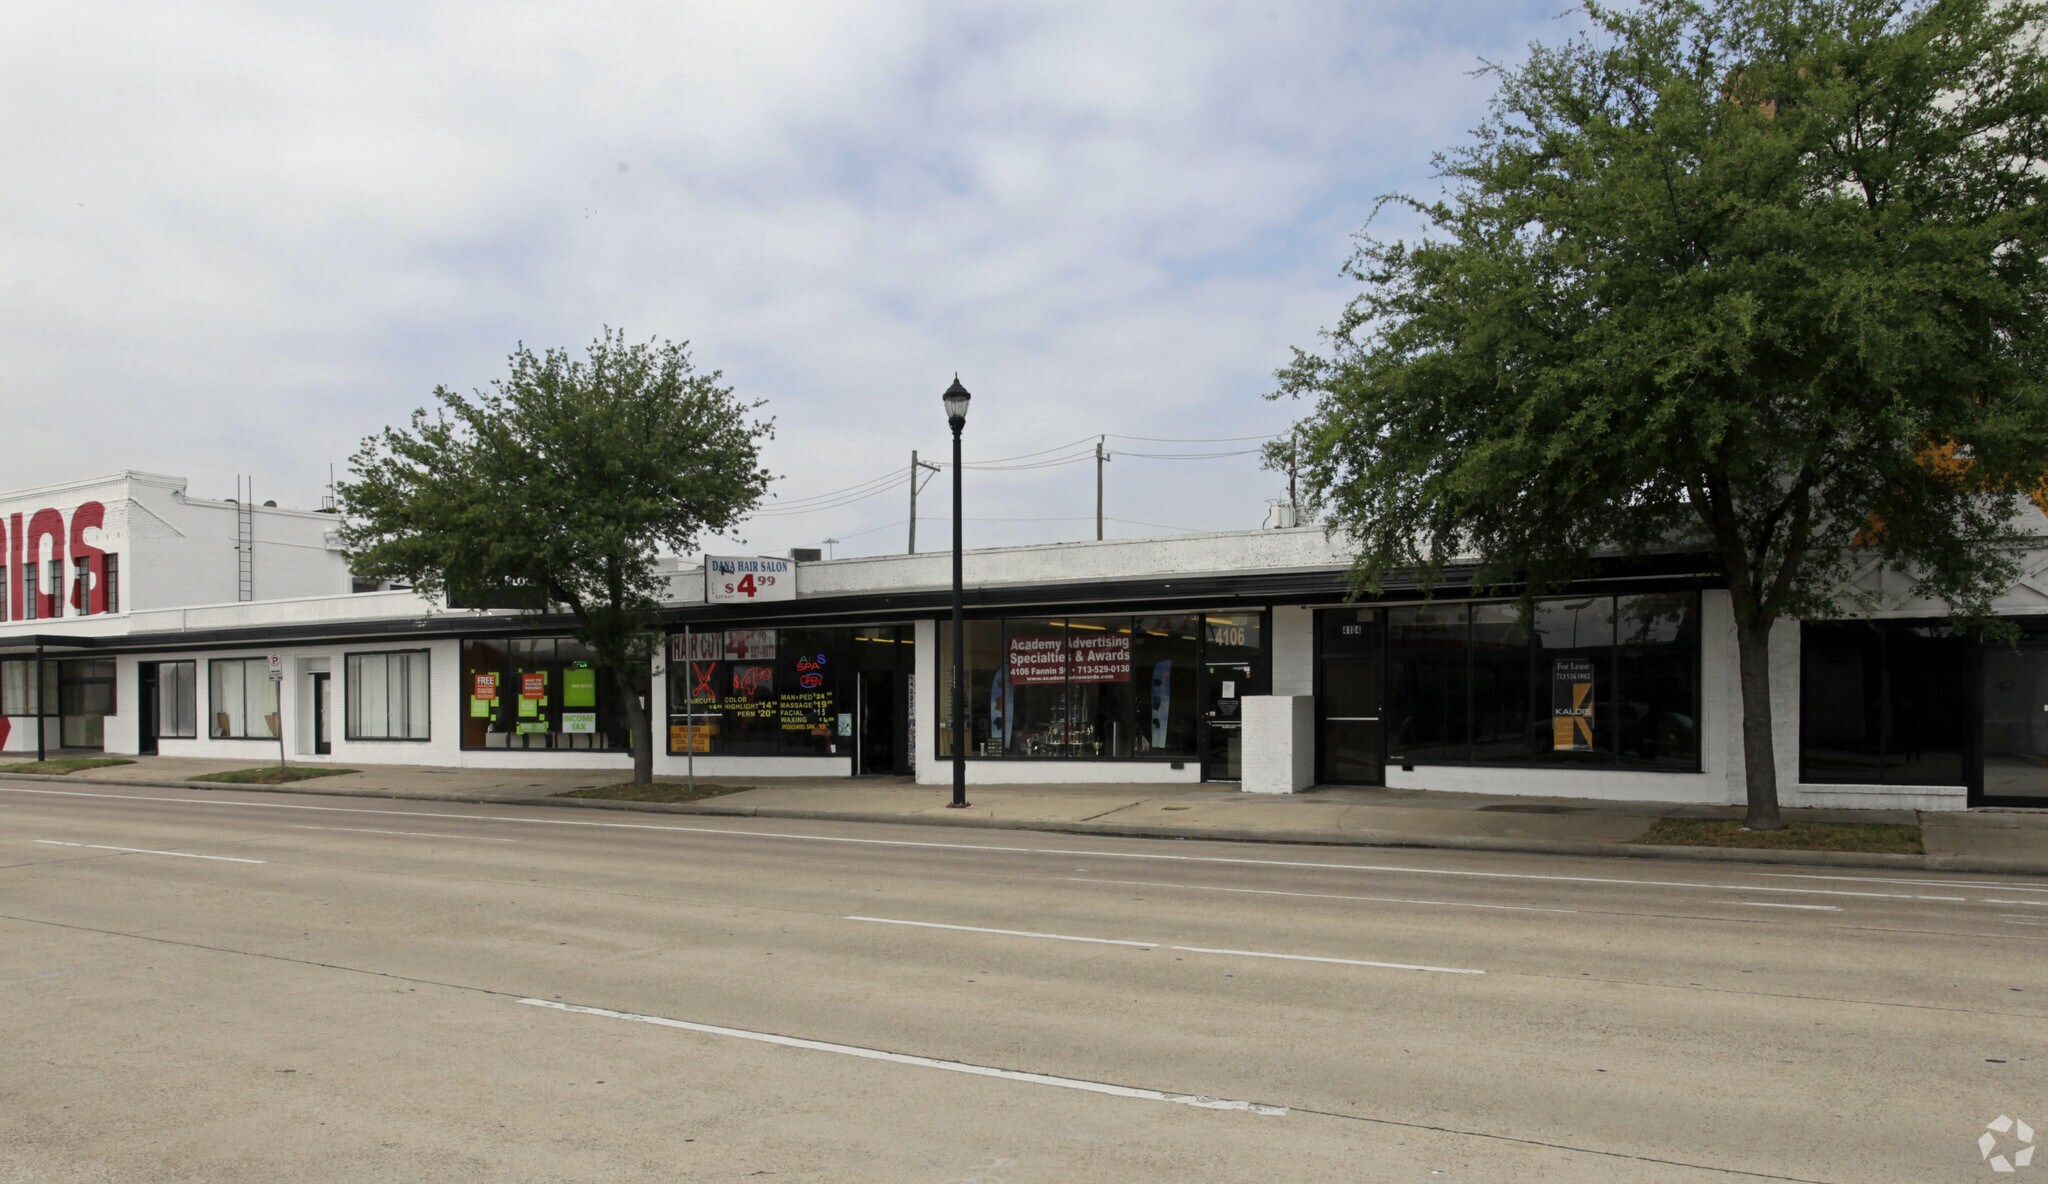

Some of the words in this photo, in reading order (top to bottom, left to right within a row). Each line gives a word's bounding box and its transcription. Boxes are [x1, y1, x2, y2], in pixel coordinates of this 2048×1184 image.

[0, 501, 105, 621] IOS
[712, 561, 735, 572] DANA
[738, 562, 758, 572] HAIR
[761, 562, 787, 572] SALON
[1215, 628, 1245, 646] 4106
[674, 633, 697, 659] HAR
[701, 633, 720, 658] CUT
[1011, 639, 1061, 651] Academy
[1010, 652, 1071, 666] Specialties
[1075, 651, 1083, 662] &
[1088, 649, 1130, 661] Awards
[797, 663, 820, 672] SPA
[1010, 668, 1029, 676] 4106
[1031, 667, 1056, 675] Fannin
[1077, 665, 1130, 674] 713-529-0130
[1557, 662, 1569, 670] For
[1571, 662, 1590, 670] Lease
[800, 675, 823, 687] OPEN
